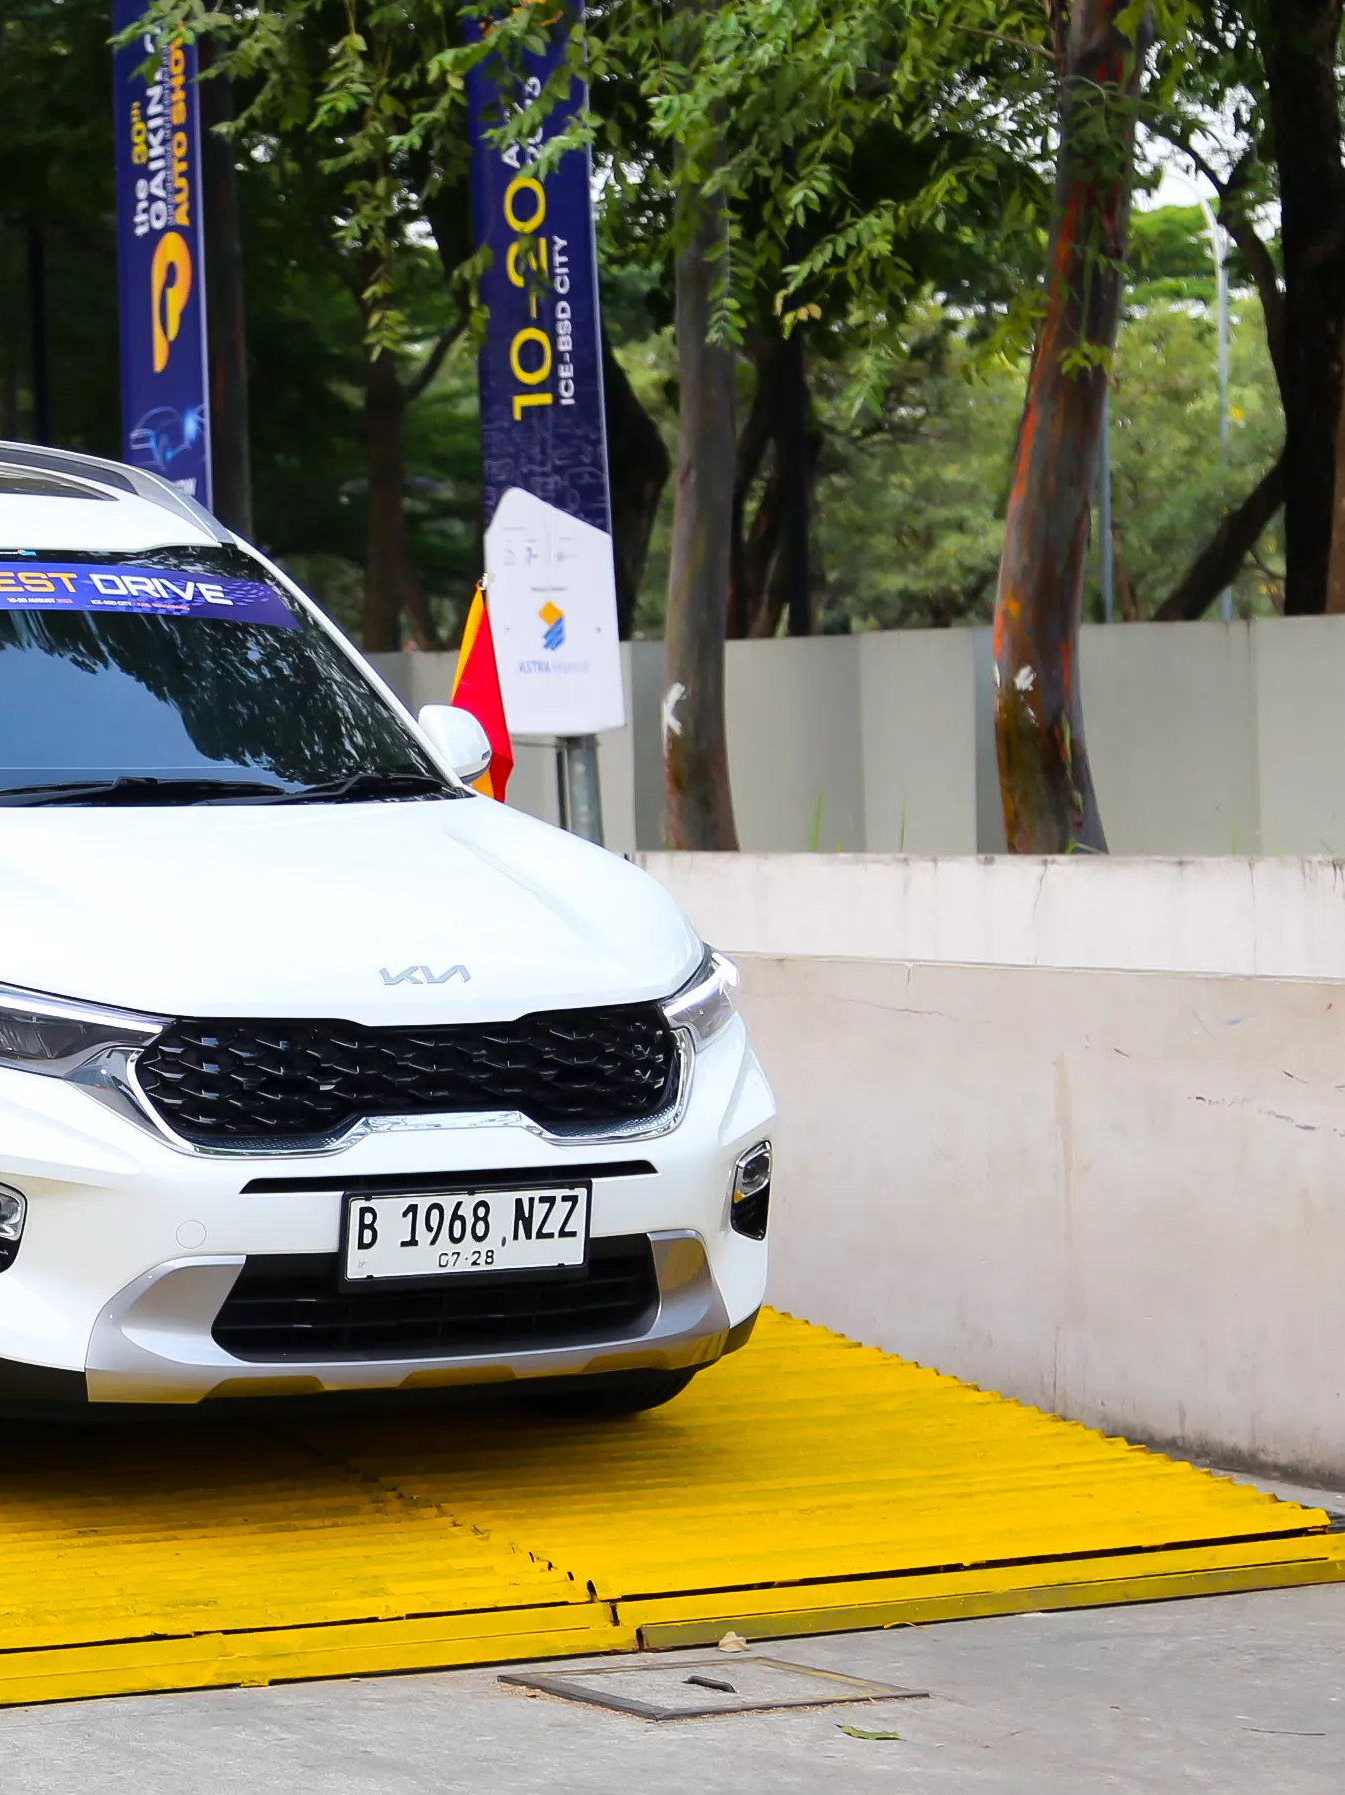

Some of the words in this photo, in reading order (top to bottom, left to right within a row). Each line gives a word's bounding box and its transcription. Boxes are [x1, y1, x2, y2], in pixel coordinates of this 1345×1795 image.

[144, 28, 168, 230] GAIKIN
[133, 178, 150, 237] the
[172, 131, 191, 227] AUTO
[552, 235, 571, 295] CITY
[504, 177, 554, 422] 10-20
[555, 300, 576, 406] ICE-BSD
[88, 573, 234, 606] DRIVE
[518, 660, 552, 674] ASTRA
[379, 965, 471, 985] KIA
[357, 1206, 378, 1250] B
[400, 1199, 491, 1248] 1968
[512, 1195, 579, 1241] NZZ
